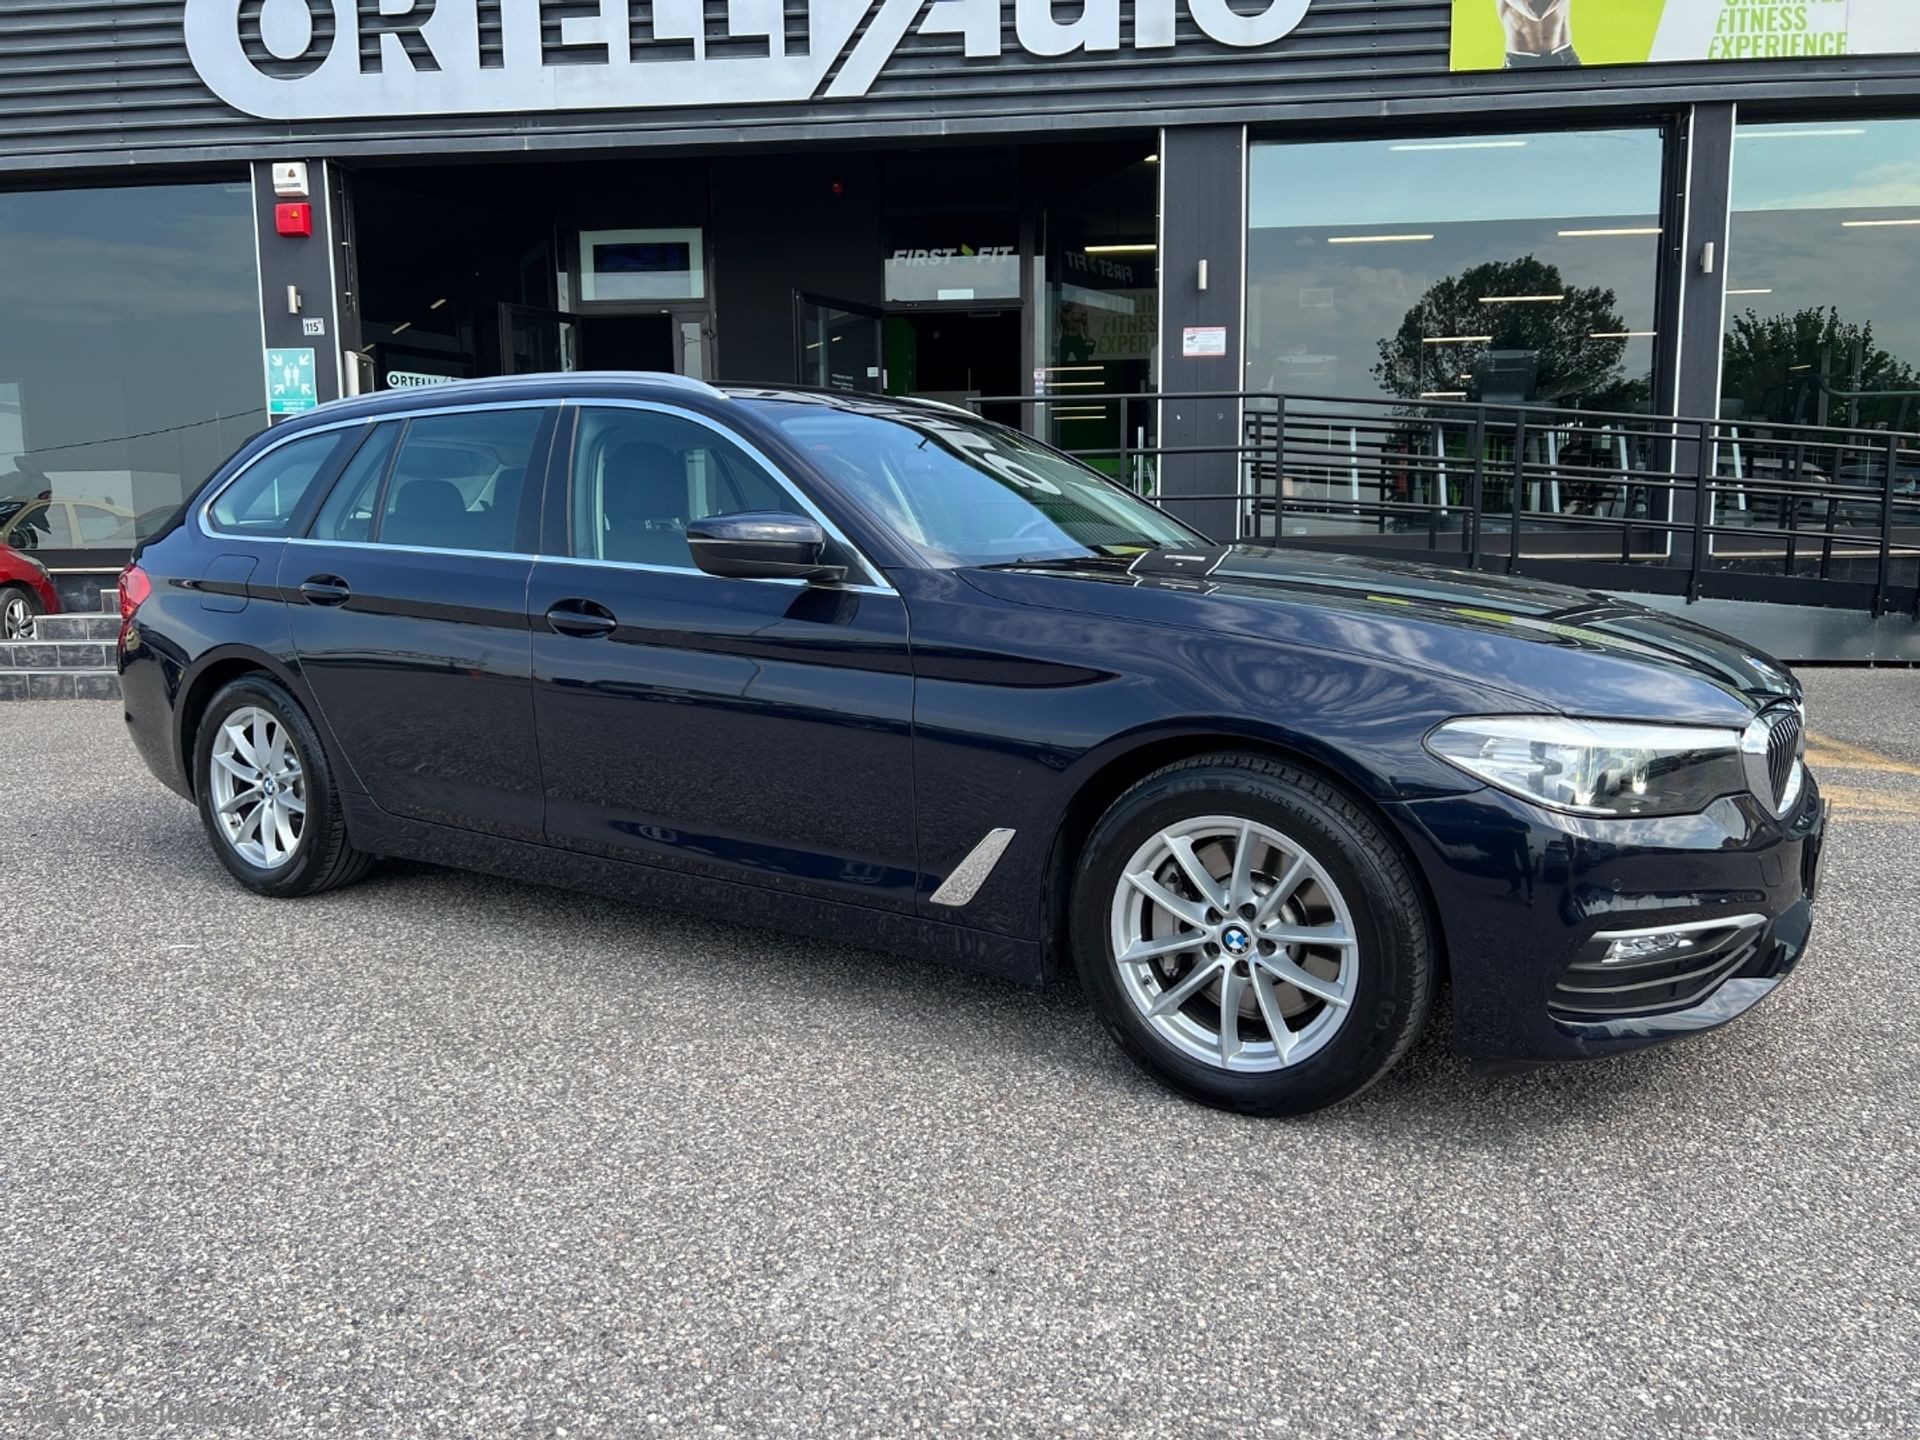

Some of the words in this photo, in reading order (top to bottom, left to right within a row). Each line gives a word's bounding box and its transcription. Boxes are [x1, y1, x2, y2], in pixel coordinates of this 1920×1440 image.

[1716, 6, 1807, 33] FITNESS
[1708, 32, 1847, 60] EXPERIENCE
[892, 248, 957, 267] FIRST
[976, 246, 1014, 264] FIT
[1247, 785, 1294, 810] 225/55
[1294, 805, 1306, 818] R
